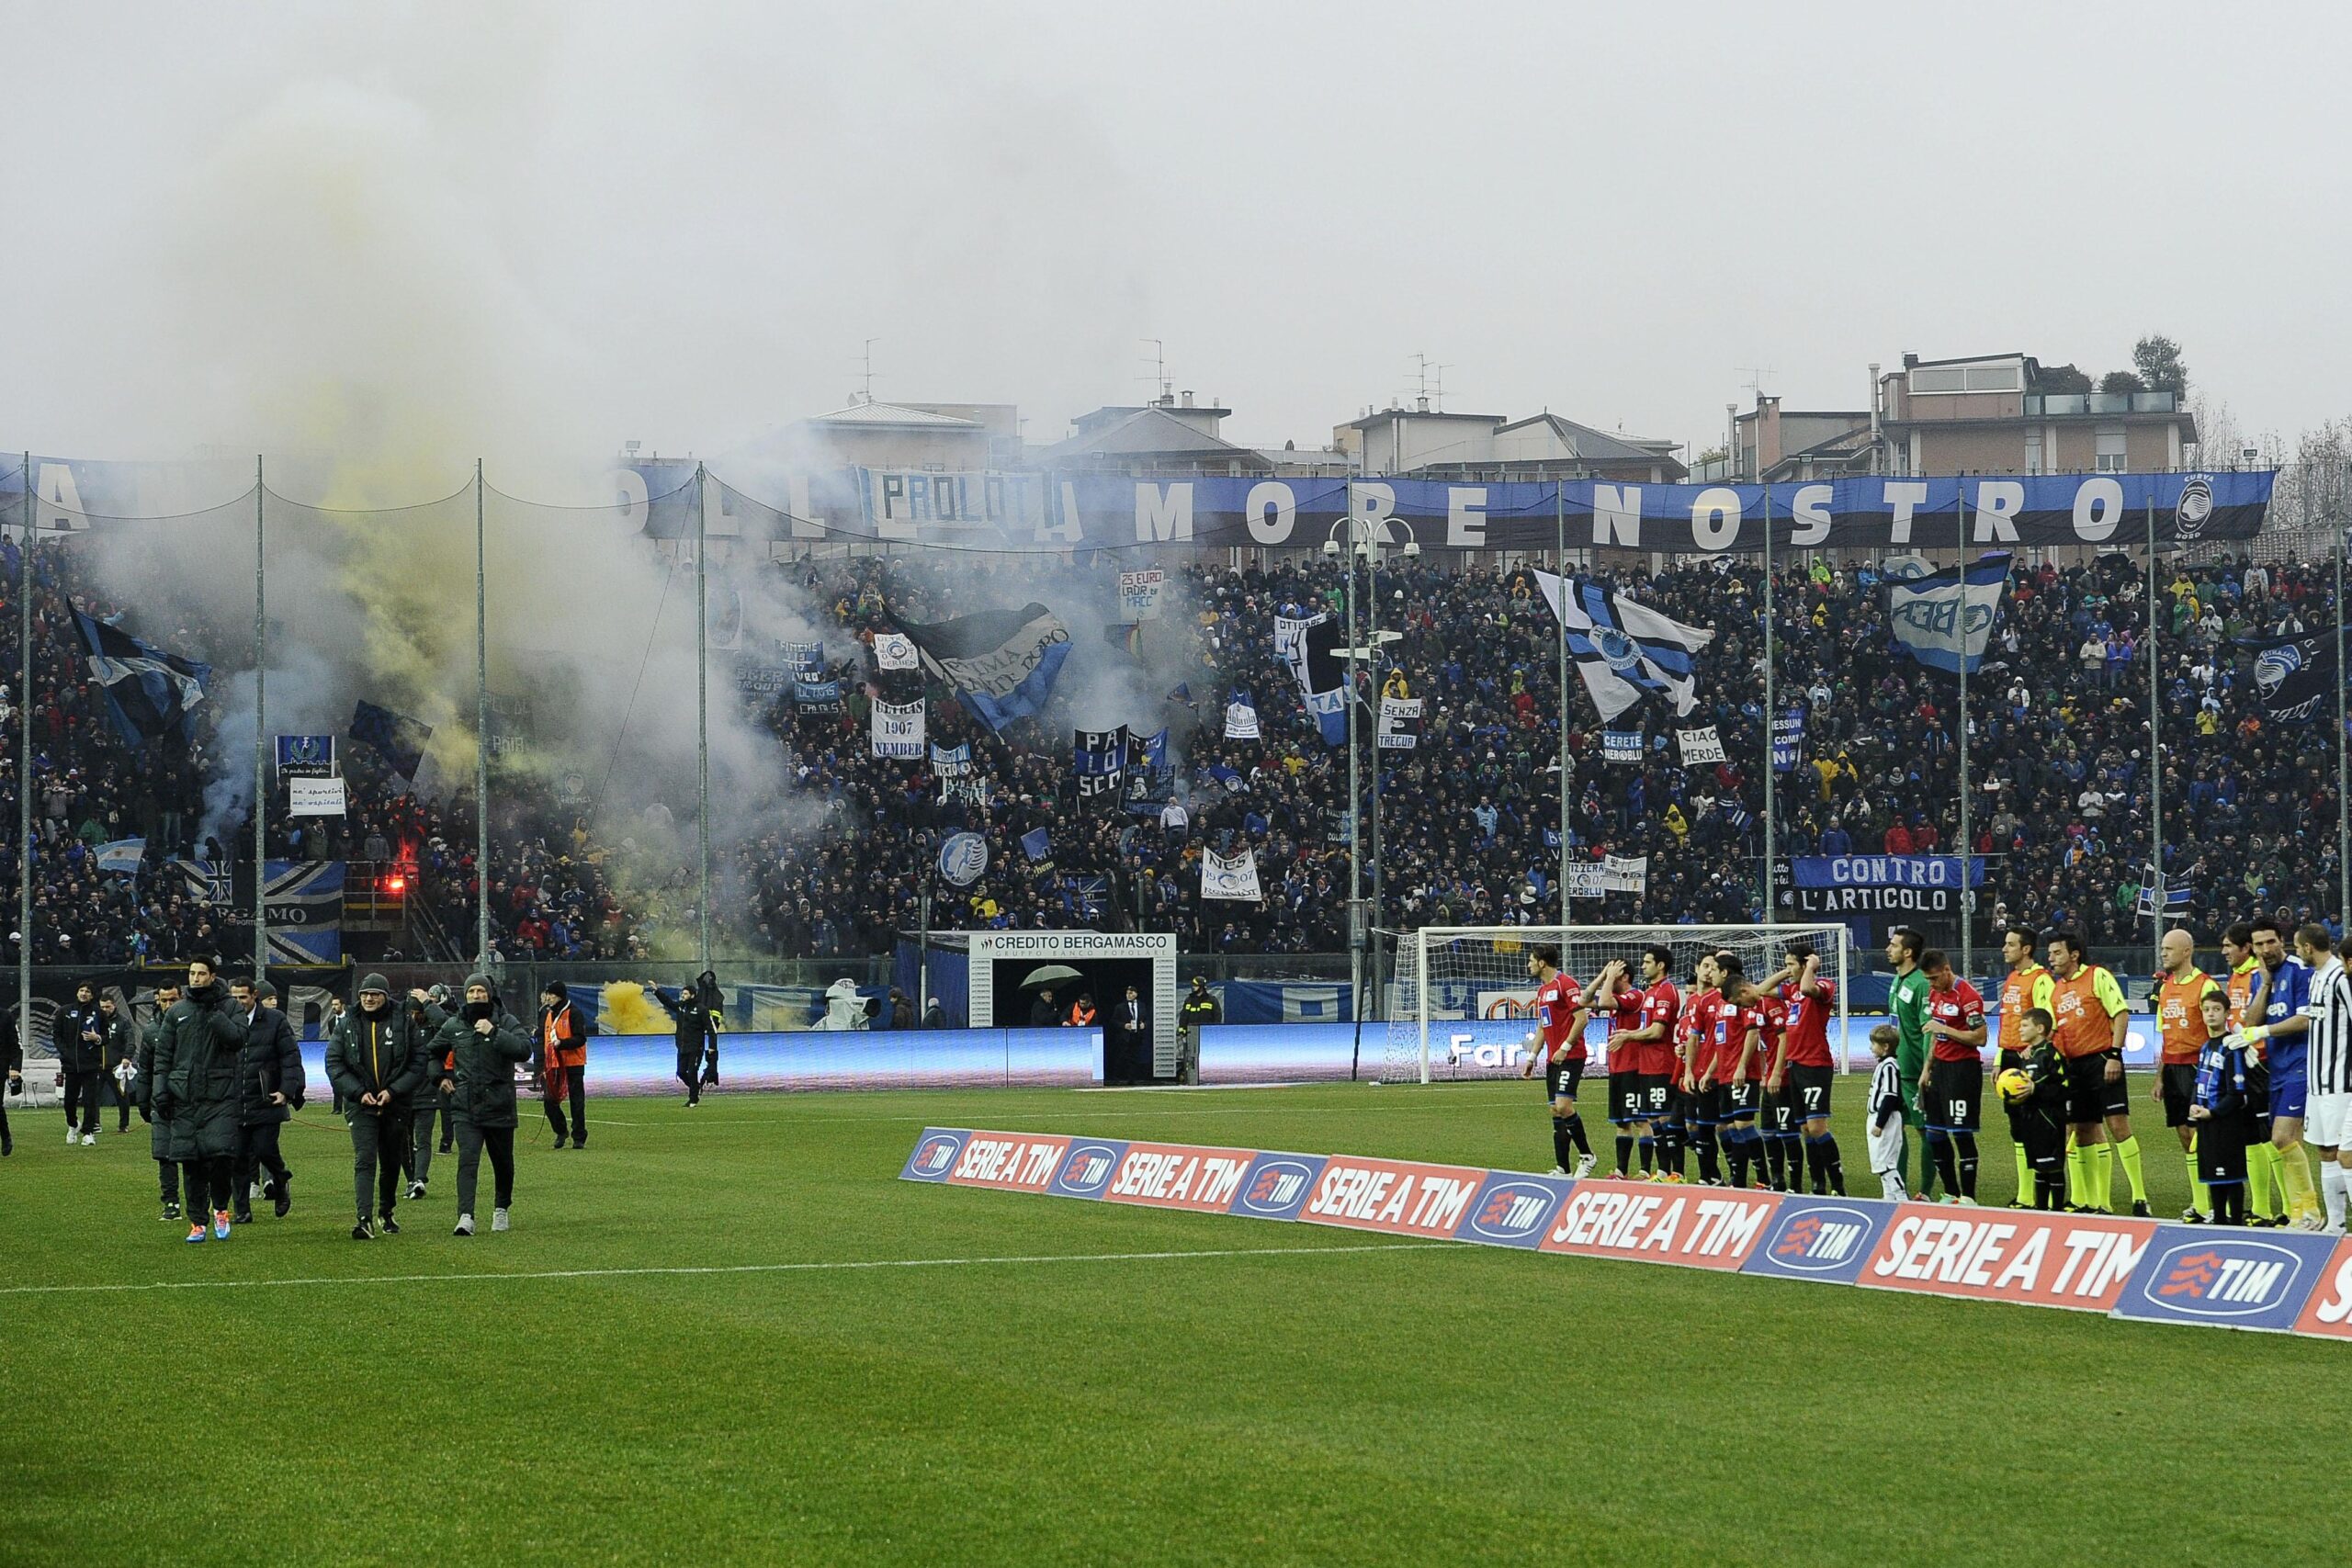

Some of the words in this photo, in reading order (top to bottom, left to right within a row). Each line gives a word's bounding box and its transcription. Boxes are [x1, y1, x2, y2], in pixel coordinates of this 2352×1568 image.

[2184, 473, 2214, 482] CURVA
[1592, 479, 2123, 550] NOSTRO
[1122, 574, 1133, 585] 25
[1136, 571, 1161, 584] EURO
[1279, 617, 1322, 630] OTTOBRE
[875, 700, 923, 715] ULTRAS
[1385, 704, 1419, 716] SENZA
[885, 721, 913, 735] 1907
[1085, 730, 1119, 752] PA
[1379, 735, 1415, 747] TREGUA
[1604, 735, 1642, 748] CERETE
[1682, 730, 1718, 743] CIAO
[875, 742, 922, 756] NEMBER
[1682, 748, 1725, 761] MERDE
[933, 761, 958, 777] TERZO
[1088, 750, 1117, 773] LO
[308, 786, 343, 795] sportivi
[1832, 858, 1946, 885] CONTRO
[1801, 887, 1947, 911] L'ARTICOLO
[995, 936, 1059, 949] CREDITO
[1064, 936, 1167, 949] BERGAMASCO
[1559, 1071, 1571, 1085] 2
[1625, 1093, 1642, 1108] 21
[1649, 1088, 1667, 1102] 28
[1804, 1087, 1823, 1105] 77
[1776, 1107, 1791, 1123] 17
[1949, 1100, 1967, 1117] 19
[928, 1145, 955, 1169] TIM
[955, 1140, 1013, 1181] SERIE
[999, 1143, 1026, 1183] A
[1018, 1144, 1064, 1186] TIM
[1080, 1157, 1110, 1184] TIM
[1112, 1152, 1183, 1198] SERIE
[1167, 1156, 1199, 1201] A
[1193, 1157, 1250, 1204] TIM
[1268, 1174, 1304, 1203] TIM
[1309, 1167, 1396, 1221] SERIE
[1376, 1175, 1415, 1224] A
[1408, 1177, 1476, 1230] TIM
[1502, 1196, 1546, 1229] TIM
[1552, 1191, 1663, 1249] SERIE
[1639, 1197, 1686, 1252] A
[1681, 1200, 1770, 1258] TIM
[1806, 1223, 1860, 1260] TIM
[1874, 1216, 2018, 1287] SERIE
[1993, 1227, 2052, 1292] A
[2051, 1230, 2151, 1298] TIM
[2206, 1258, 2285, 1303] TIM
